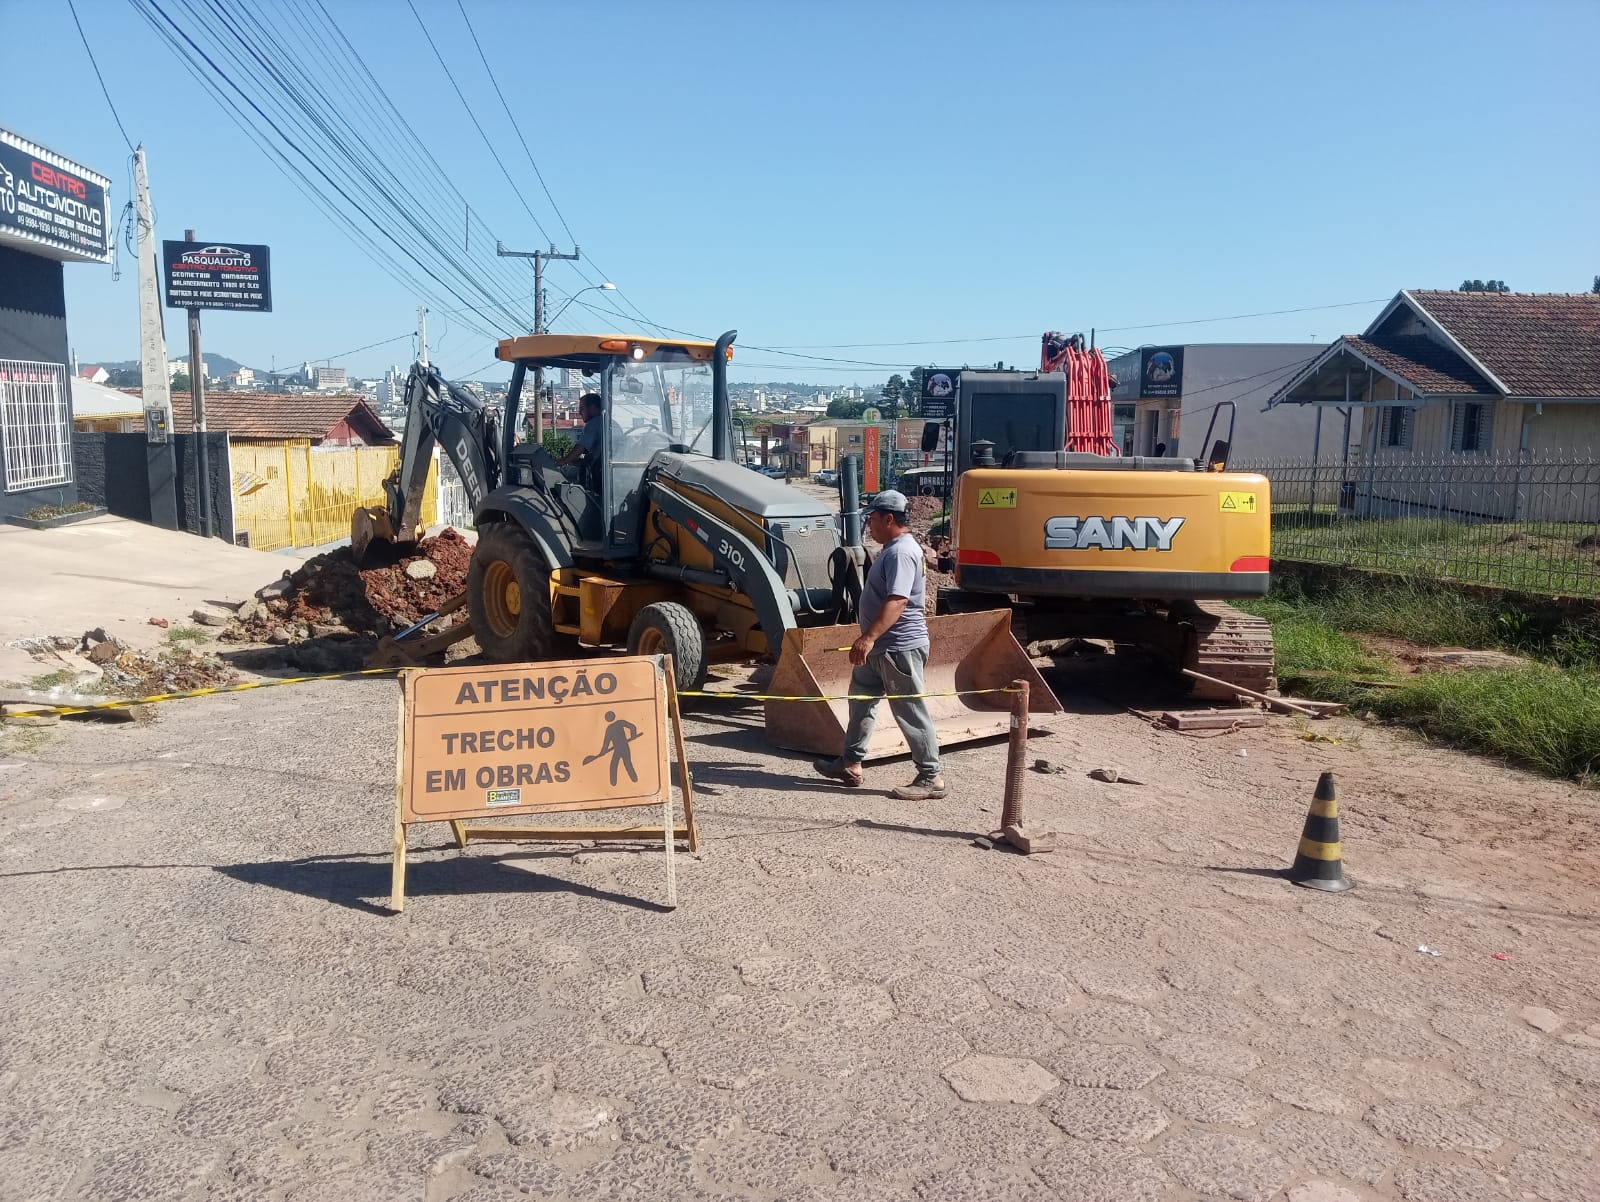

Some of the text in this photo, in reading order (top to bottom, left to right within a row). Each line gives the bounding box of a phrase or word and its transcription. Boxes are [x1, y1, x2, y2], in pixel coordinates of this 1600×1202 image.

[31, 161, 87, 199] CENTRO
[17, 179, 102, 226] AUTOMOTIVO
[182, 256, 251, 266] PASQUALOTTO
[456, 437, 482, 506] DEER
[1044, 516, 1186, 551] SANY
[718, 538, 746, 573] 310L
[455, 669, 617, 705] ATENÇÃO
[441, 726, 555, 755] TRECHO
[426, 761, 571, 793] EM OBRAS
